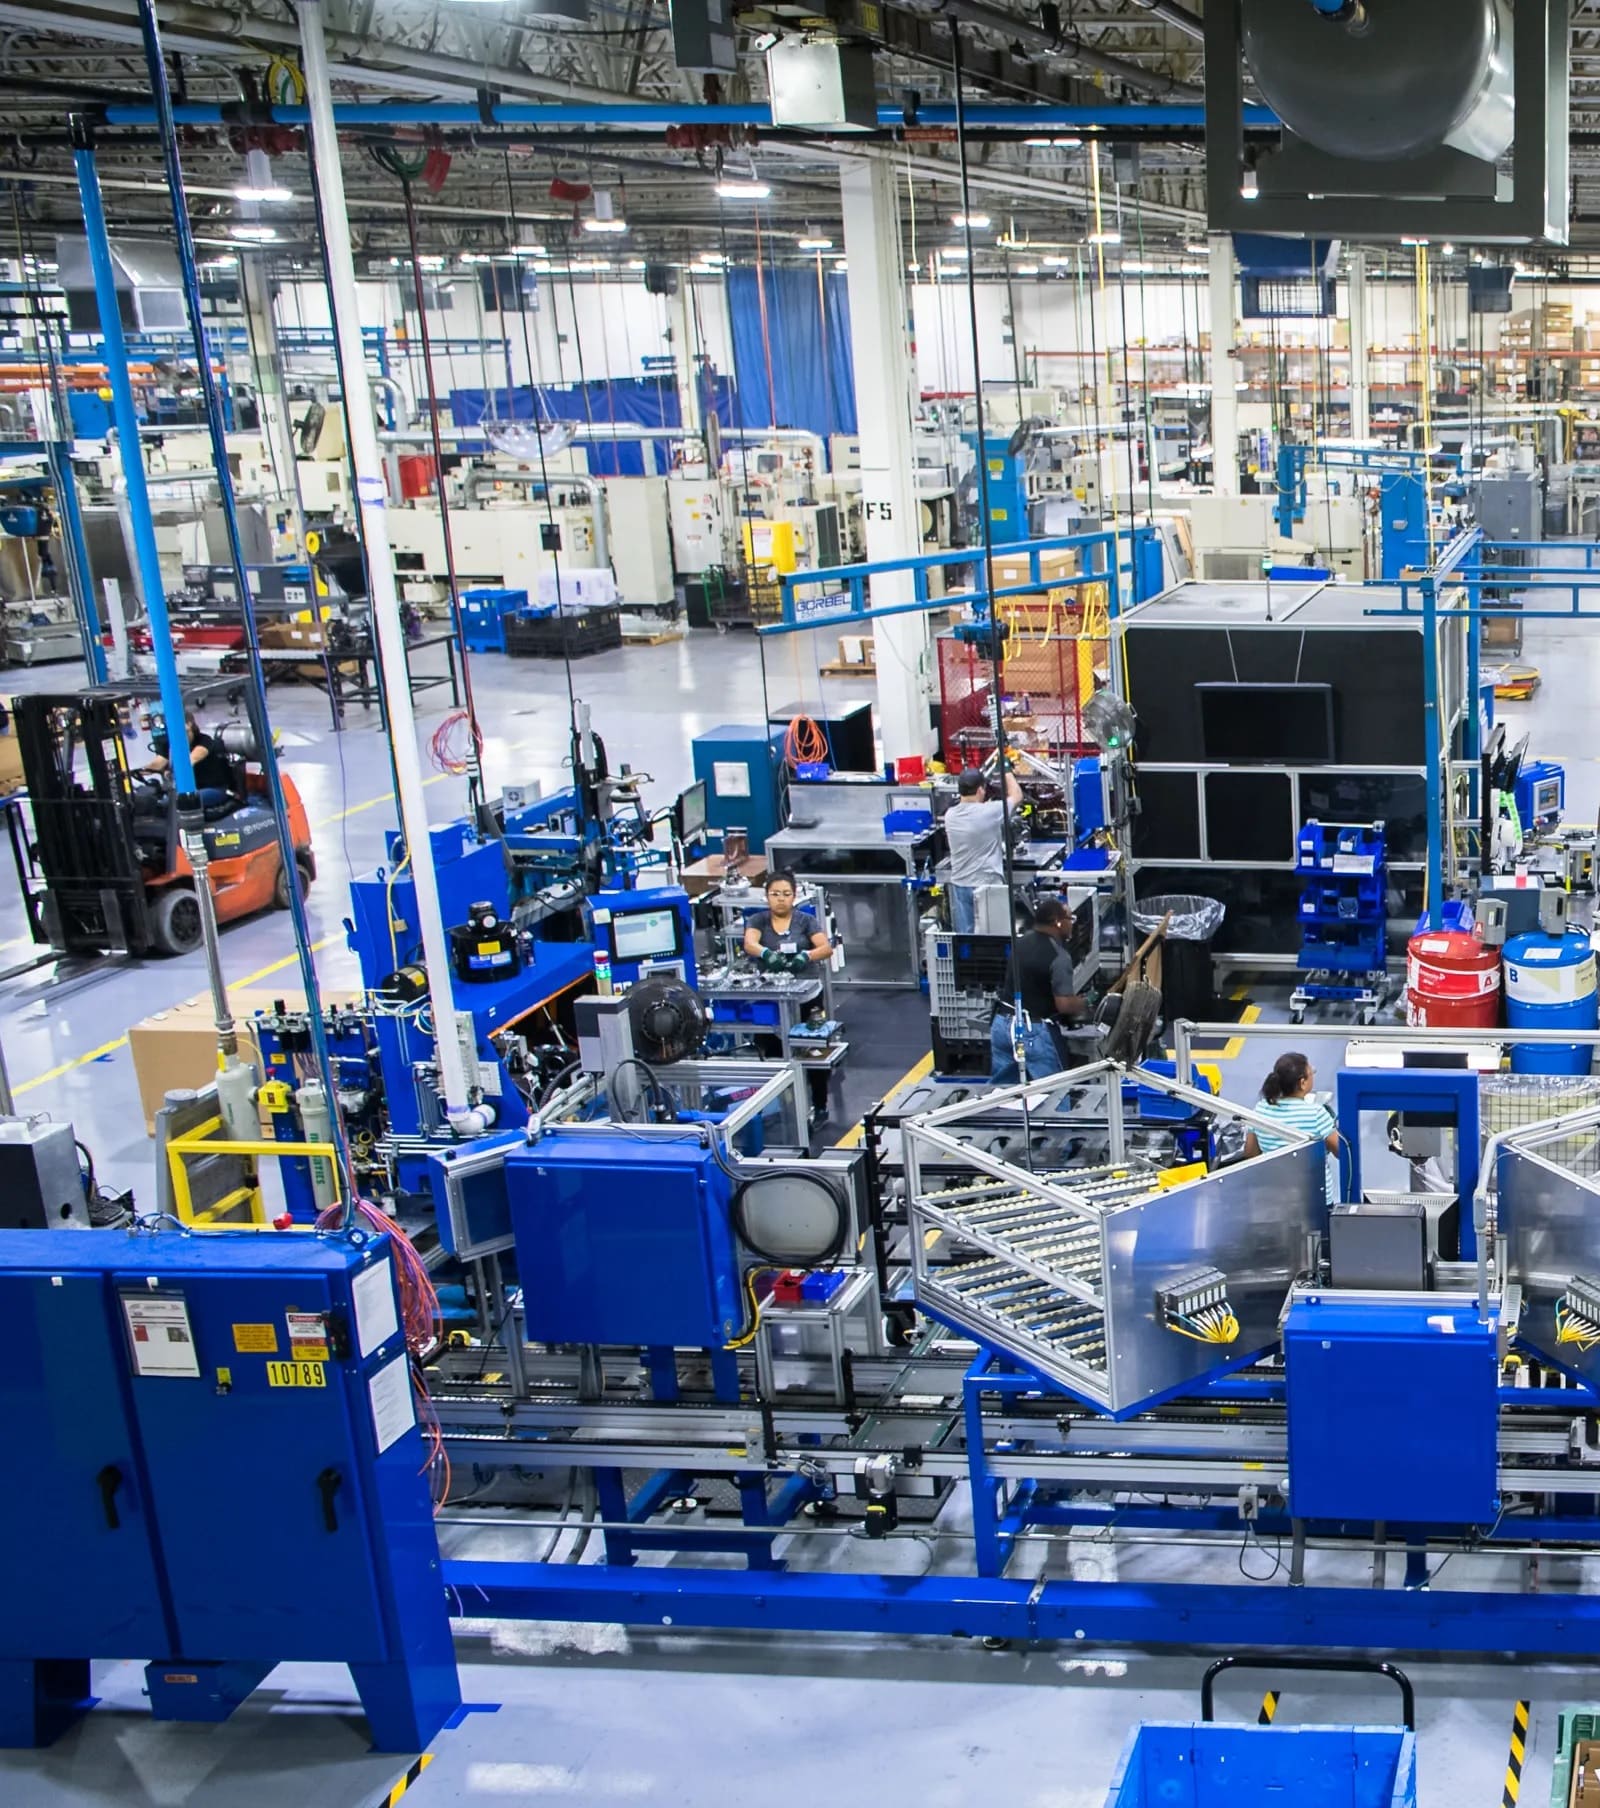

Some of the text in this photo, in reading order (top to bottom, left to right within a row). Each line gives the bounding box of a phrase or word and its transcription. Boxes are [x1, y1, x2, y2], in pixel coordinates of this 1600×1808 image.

[866, 502, 892, 520] F5
[796, 595, 850, 612] GORBEL
[1484, 976, 1493, 987] A
[1509, 968, 1519, 983] B
[270, 1363, 323, 1385] 10789
